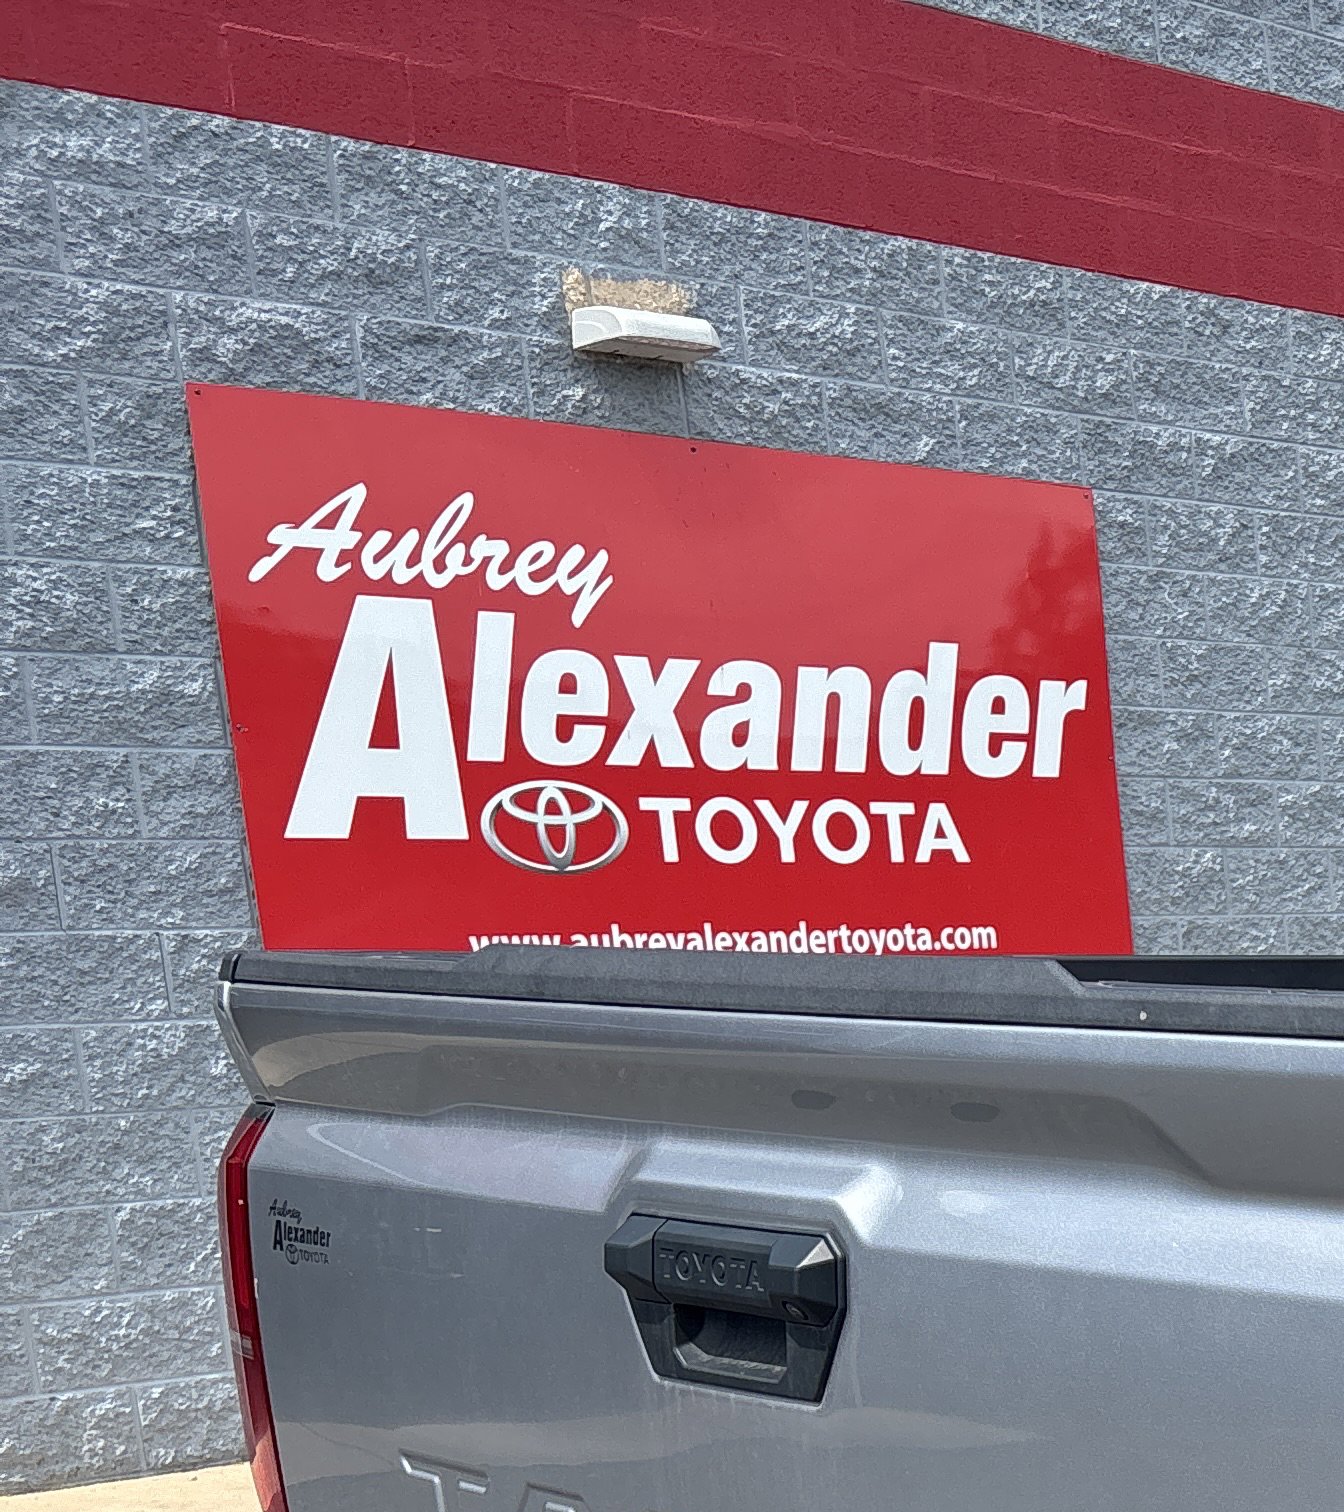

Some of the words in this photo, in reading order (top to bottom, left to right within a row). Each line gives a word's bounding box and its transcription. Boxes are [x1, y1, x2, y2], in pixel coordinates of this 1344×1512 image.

[248, 481, 614, 627] Aubrey
[283, 594, 1088, 841] Alexander
[639, 795, 970, 865] TOYOTA
[468, 921, 997, 955] waubreyalexandertoyota.com
[272, 1219, 331, 1252] Alexander
[299, 1249, 330, 1264] TOYOTA
[658, 1247, 765, 1292] TOYOTA
